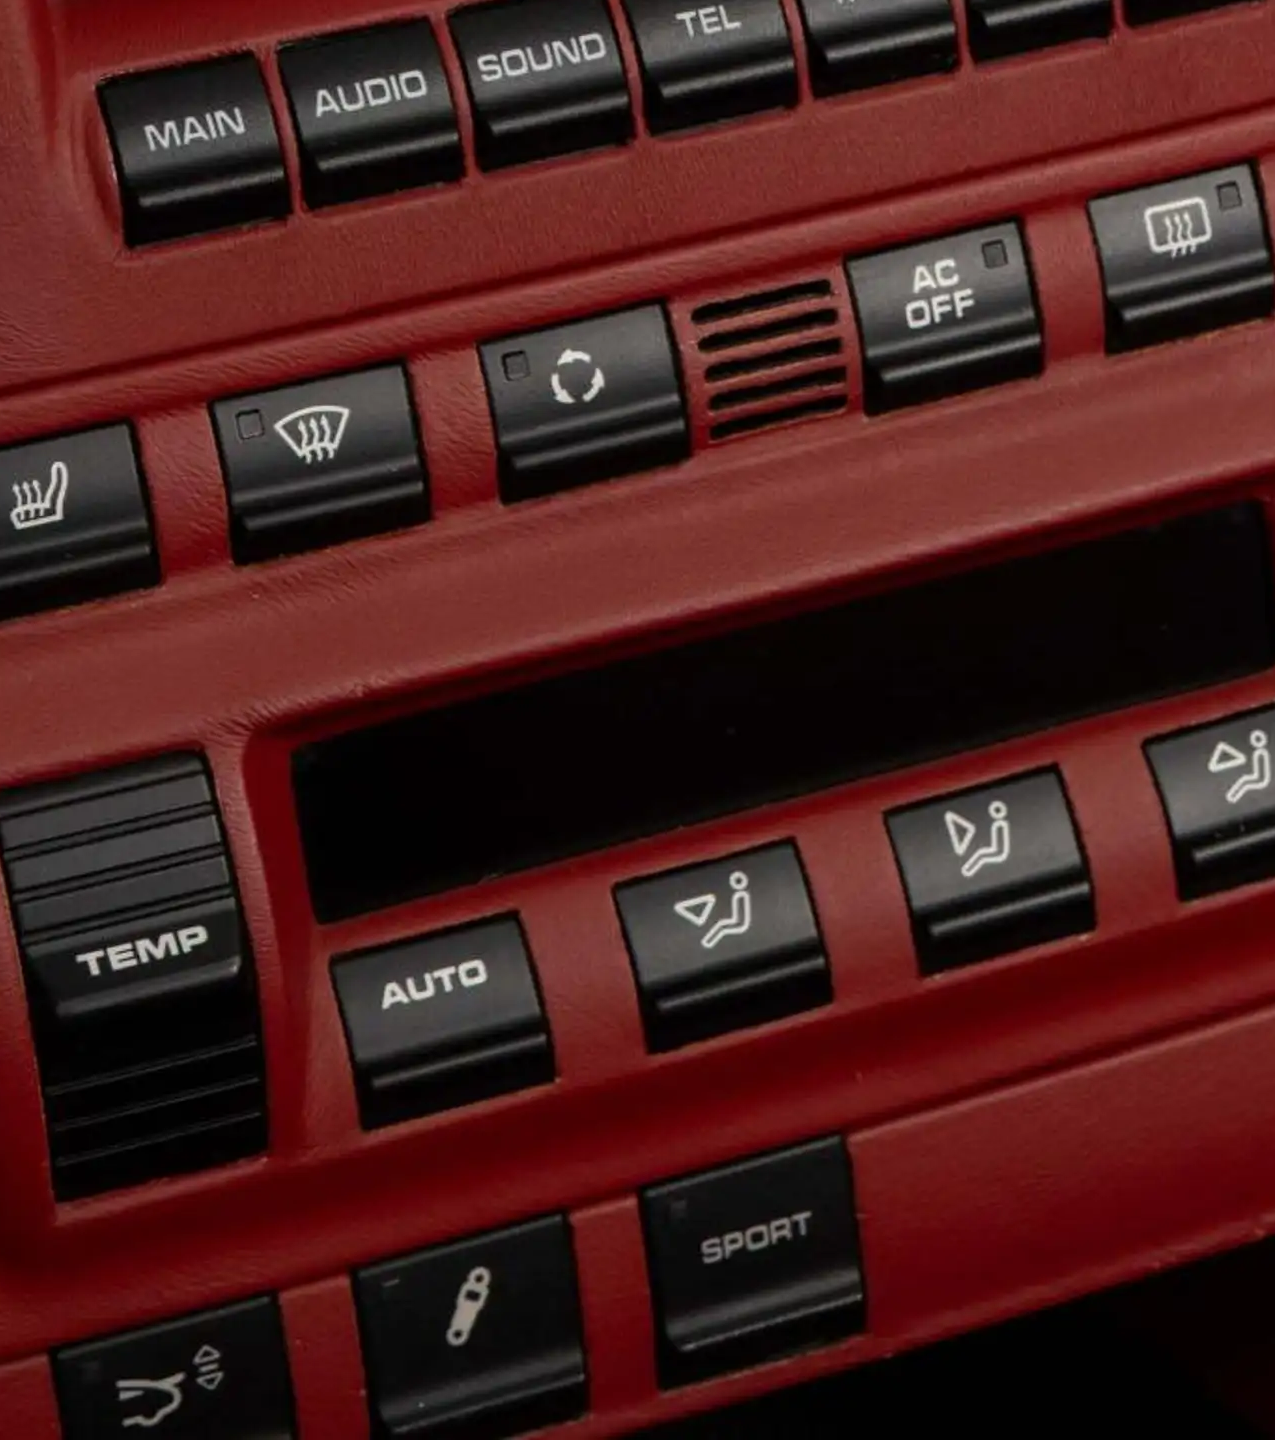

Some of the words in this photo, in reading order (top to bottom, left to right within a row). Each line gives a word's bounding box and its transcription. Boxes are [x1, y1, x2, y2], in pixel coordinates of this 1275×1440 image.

[675, 5, 743, 39] TEL
[476, 32, 608, 83] SOUND
[315, 69, 428, 118] AUDIO
[144, 107, 246, 152] MAIN
[913, 258, 960, 294] AC
[905, 288, 975, 329] OFF
[76, 925, 208, 976] TEMP
[381, 959, 488, 1010] AUTO
[701, 1211, 812, 1264] SPORT
